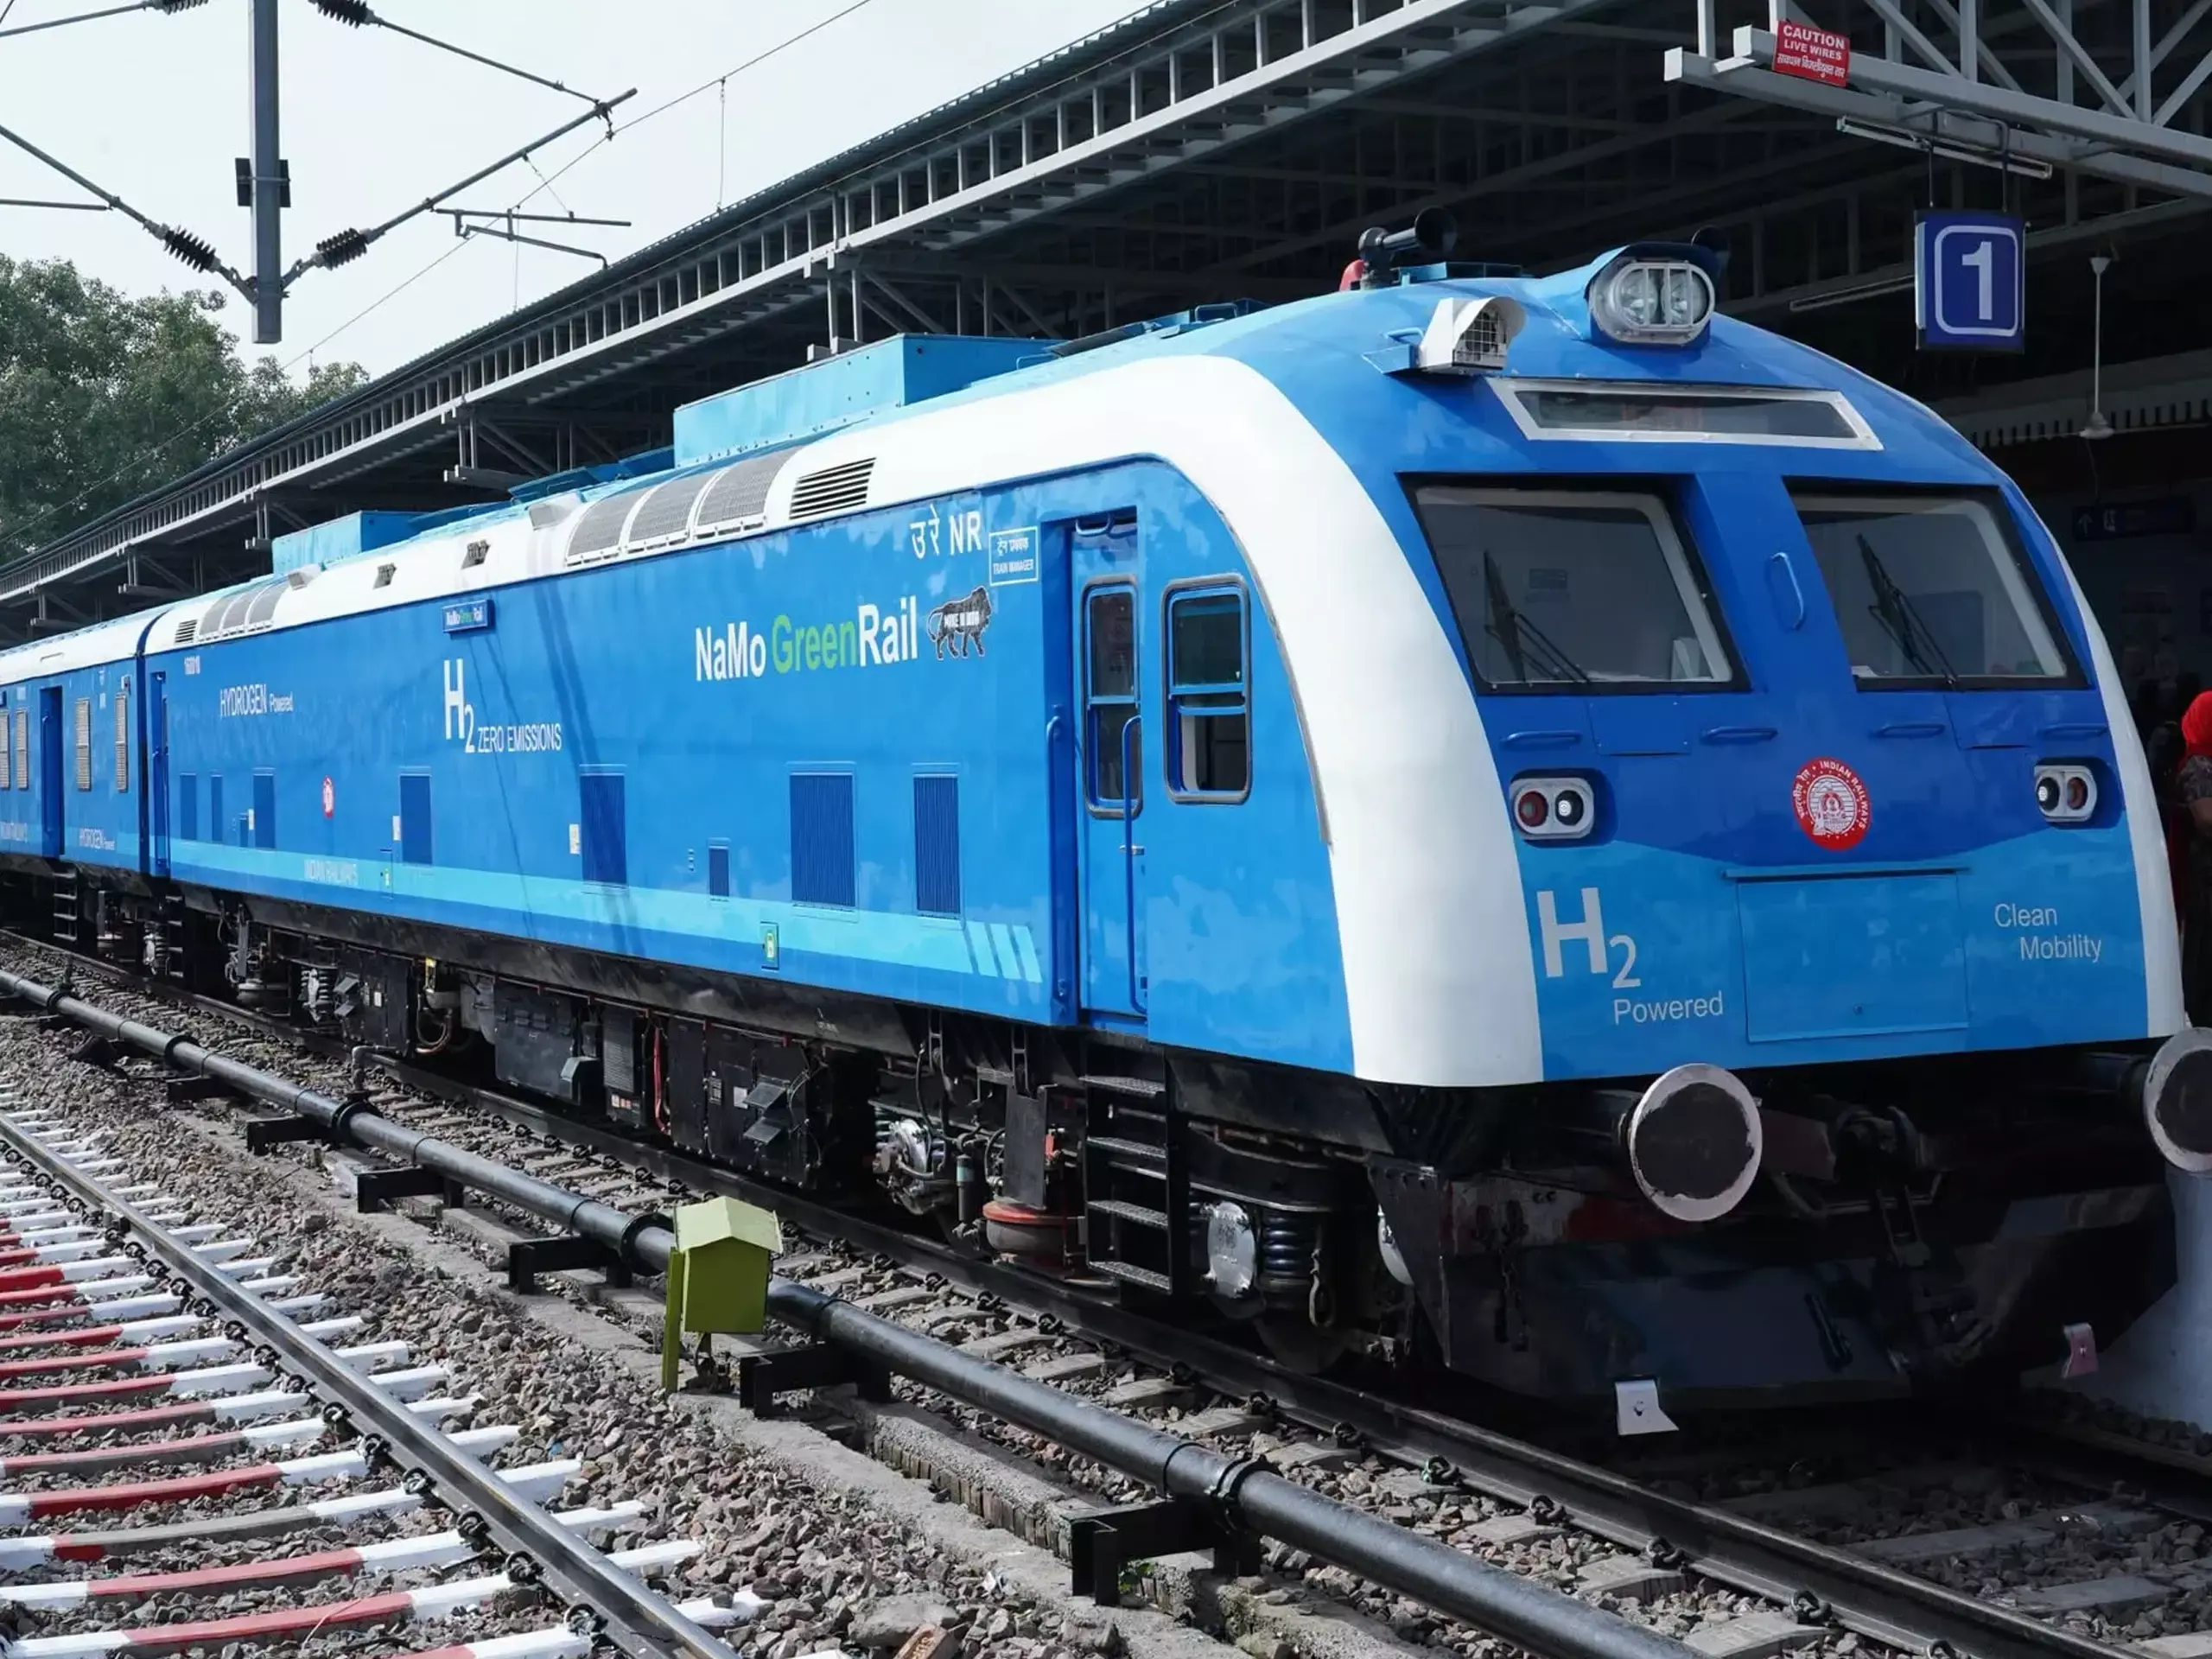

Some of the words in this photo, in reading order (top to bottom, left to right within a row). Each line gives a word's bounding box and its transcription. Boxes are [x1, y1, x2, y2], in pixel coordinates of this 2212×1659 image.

[1783, 25, 1846, 49] CAUTION
[1784, 39, 1808, 53] LIVE
[1809, 45, 1843, 60] WIRES
[1961, 241, 1993, 321] 1
[949, 511, 982, 556] NR
[695, 621, 766, 682] NaMo
[219, 683, 267, 717] HYDROGEN
[477, 726, 505, 753] ZERO
[507, 723, 563, 753] EMISSIONS
[1819, 760, 1853, 778] INDIAN
[1851, 777, 1869, 830] RAILWAYS
[1994, 903, 2058, 927] Clean
[2019, 933, 2102, 963] Mobility
[1613, 989, 1725, 1026] Powered
